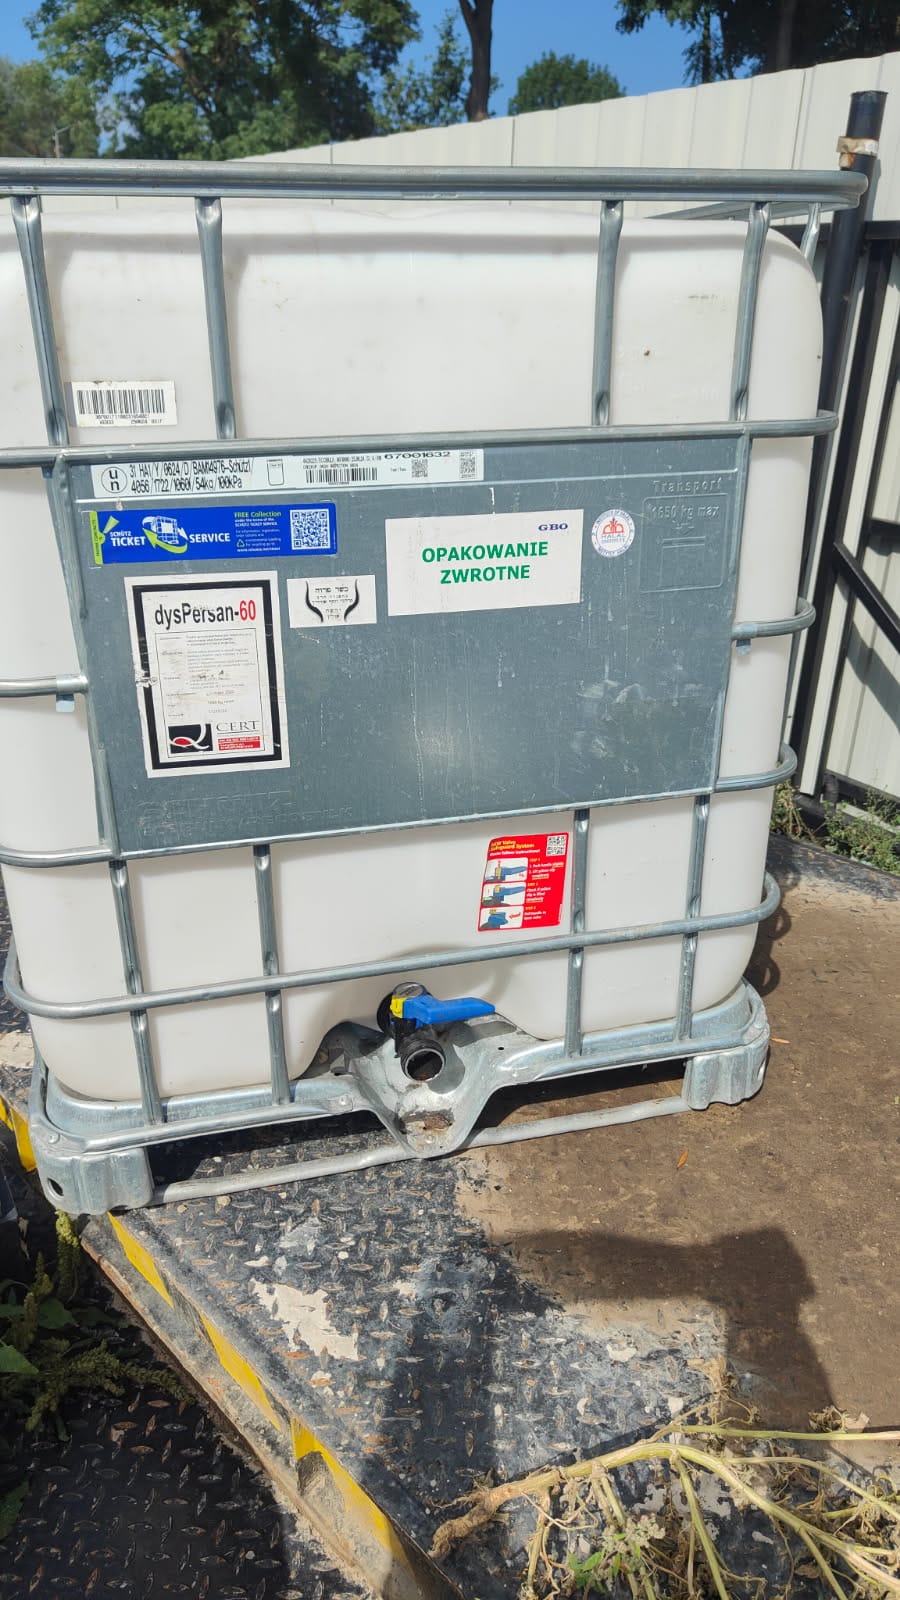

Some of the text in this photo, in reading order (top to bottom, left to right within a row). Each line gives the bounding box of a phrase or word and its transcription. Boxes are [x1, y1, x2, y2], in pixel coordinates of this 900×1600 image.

[384, 451, 450, 460] 67001632
[653, 477, 722, 494] Transport
[538, 523, 568, 531] GBO
[111, 536, 146, 547] TICKET
[189, 533, 230, 543] SERVICE
[422, 541, 548, 563] OPAKOWANIE
[440, 565, 531, 584] ZWROTNE
[155, 600, 256, 630] dysPersan-60
[216, 721, 260, 731] CERT
